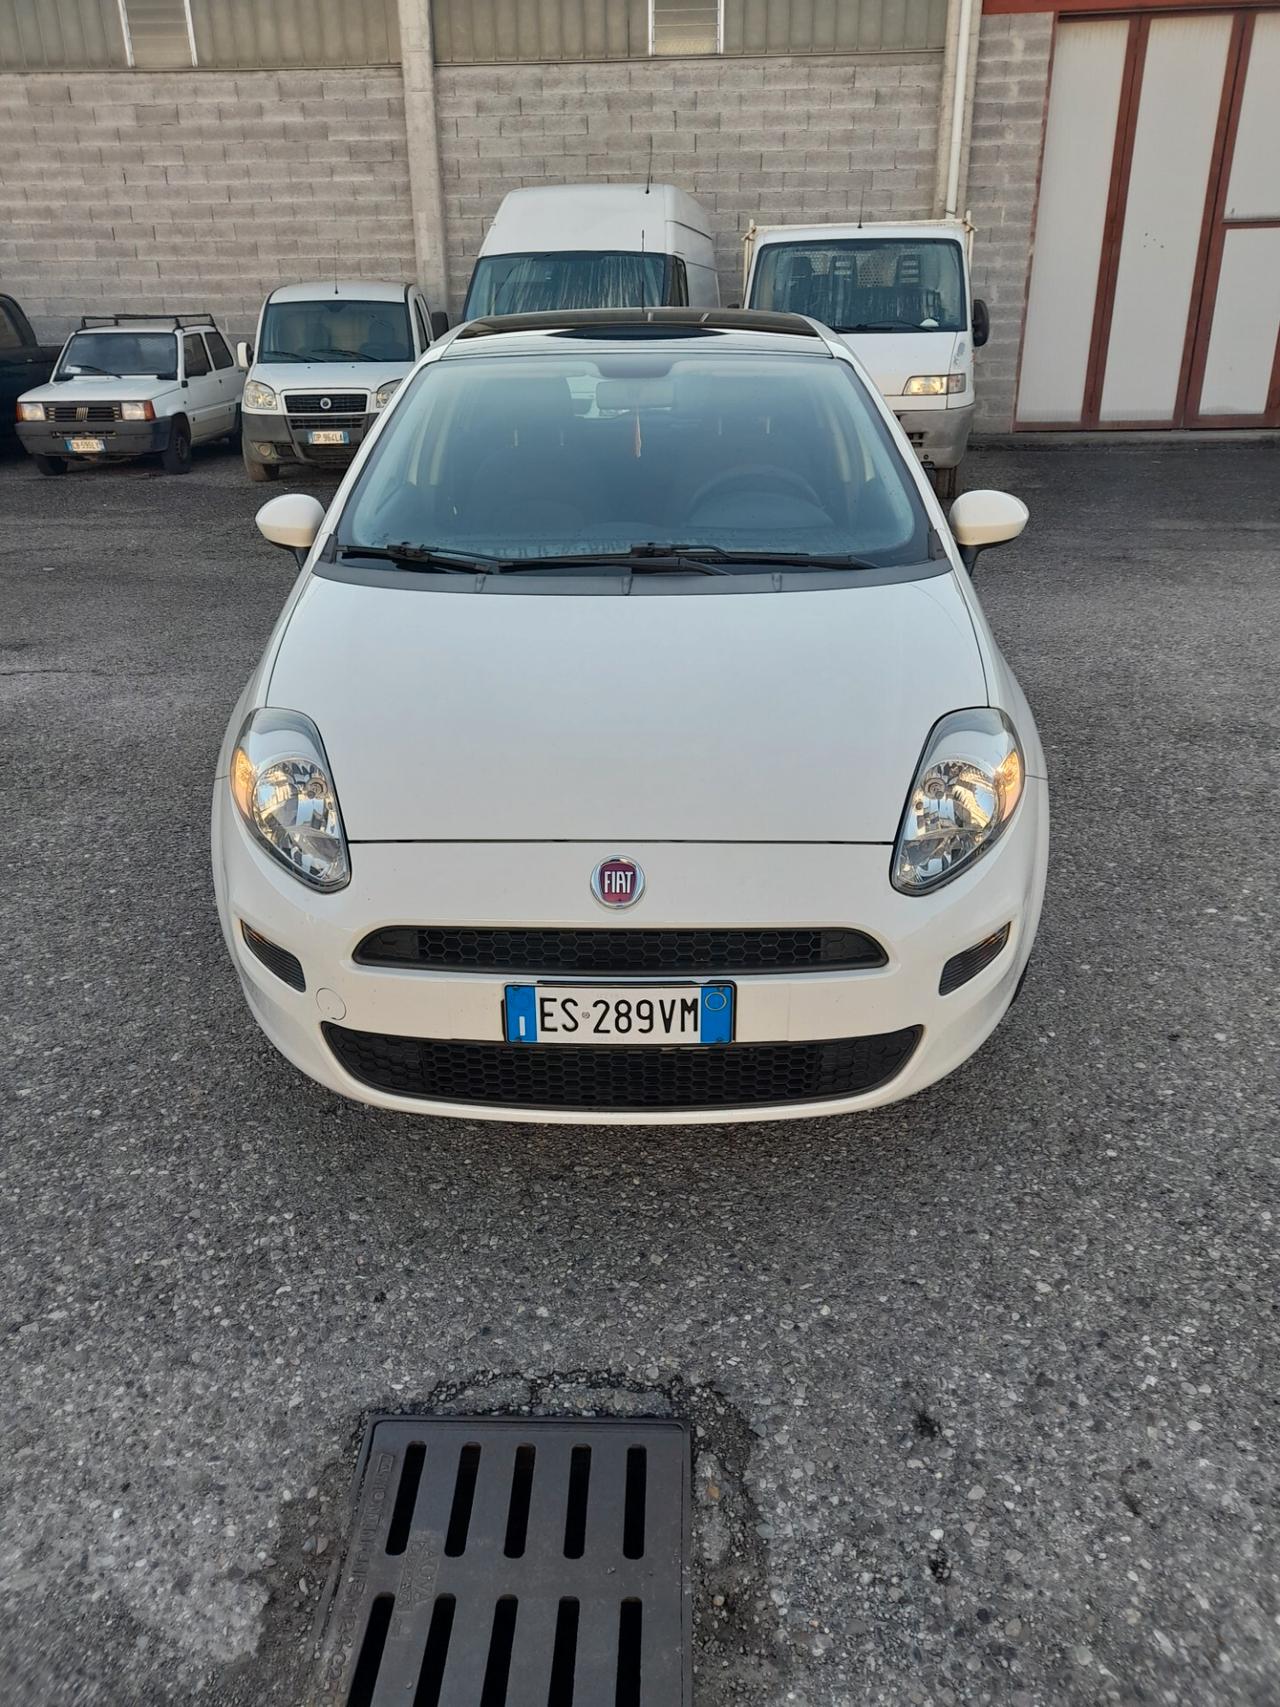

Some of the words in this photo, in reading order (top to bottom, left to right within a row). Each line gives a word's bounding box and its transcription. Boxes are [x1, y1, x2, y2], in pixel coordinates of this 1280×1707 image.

[604, 870, 634, 894] FIAT
[539, 997, 579, 1033] ES
[592, 997, 699, 1034] 289VM
